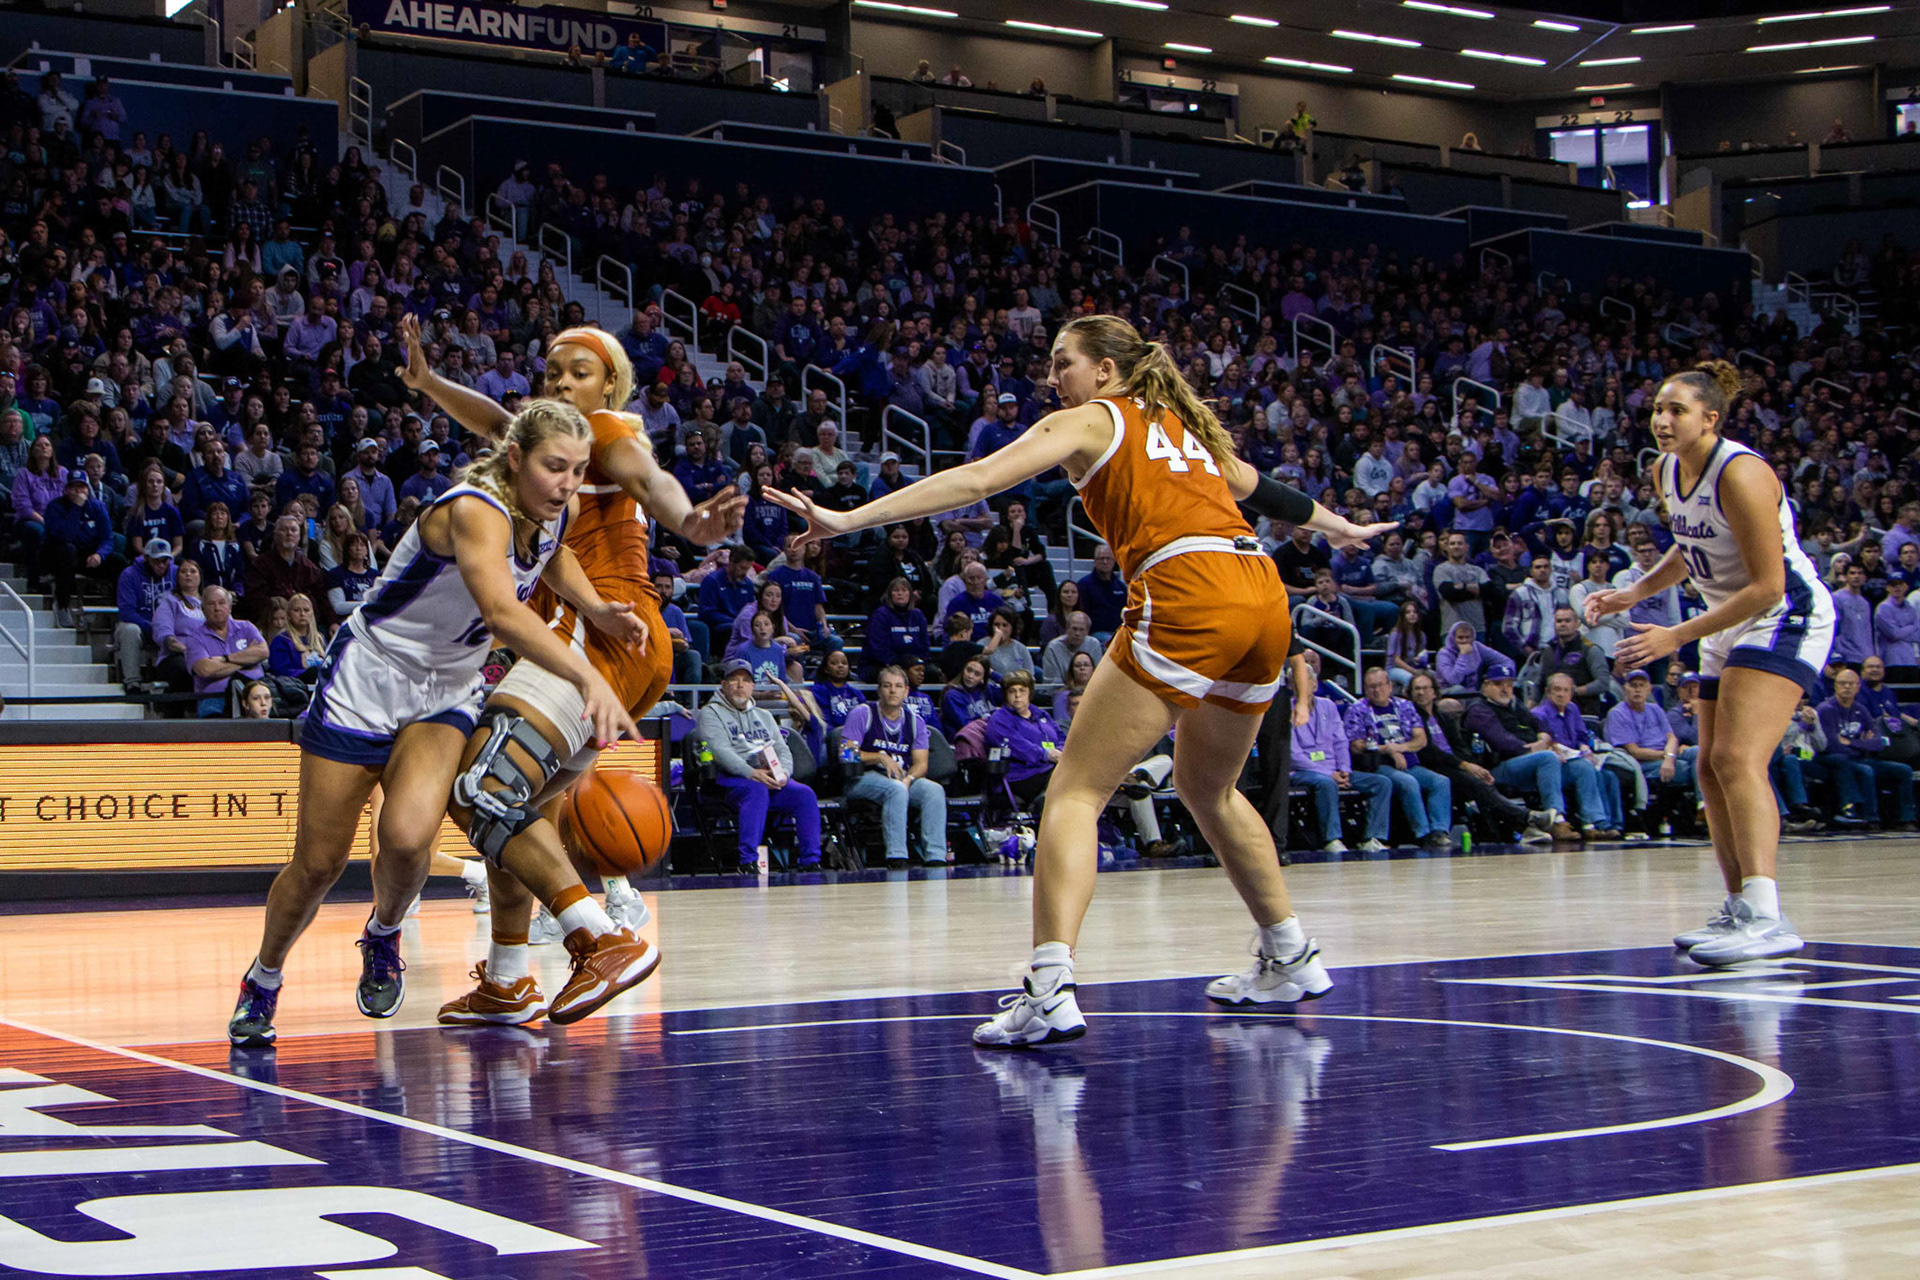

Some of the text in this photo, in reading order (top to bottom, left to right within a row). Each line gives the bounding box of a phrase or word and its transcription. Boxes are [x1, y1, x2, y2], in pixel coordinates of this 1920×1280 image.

[635, 5, 653, 19] 20
[783, 25, 799, 38] 21
[1202, 80, 1216, 93] 22
[1561, 114, 1579, 126] 22
[1615, 110, 1633, 122] 22
[1145, 421, 1221, 477] 44
[729, 726, 770, 740] WCATS
[36, 793, 190, 821] CHOICE
[213, 793, 248, 817] IN
